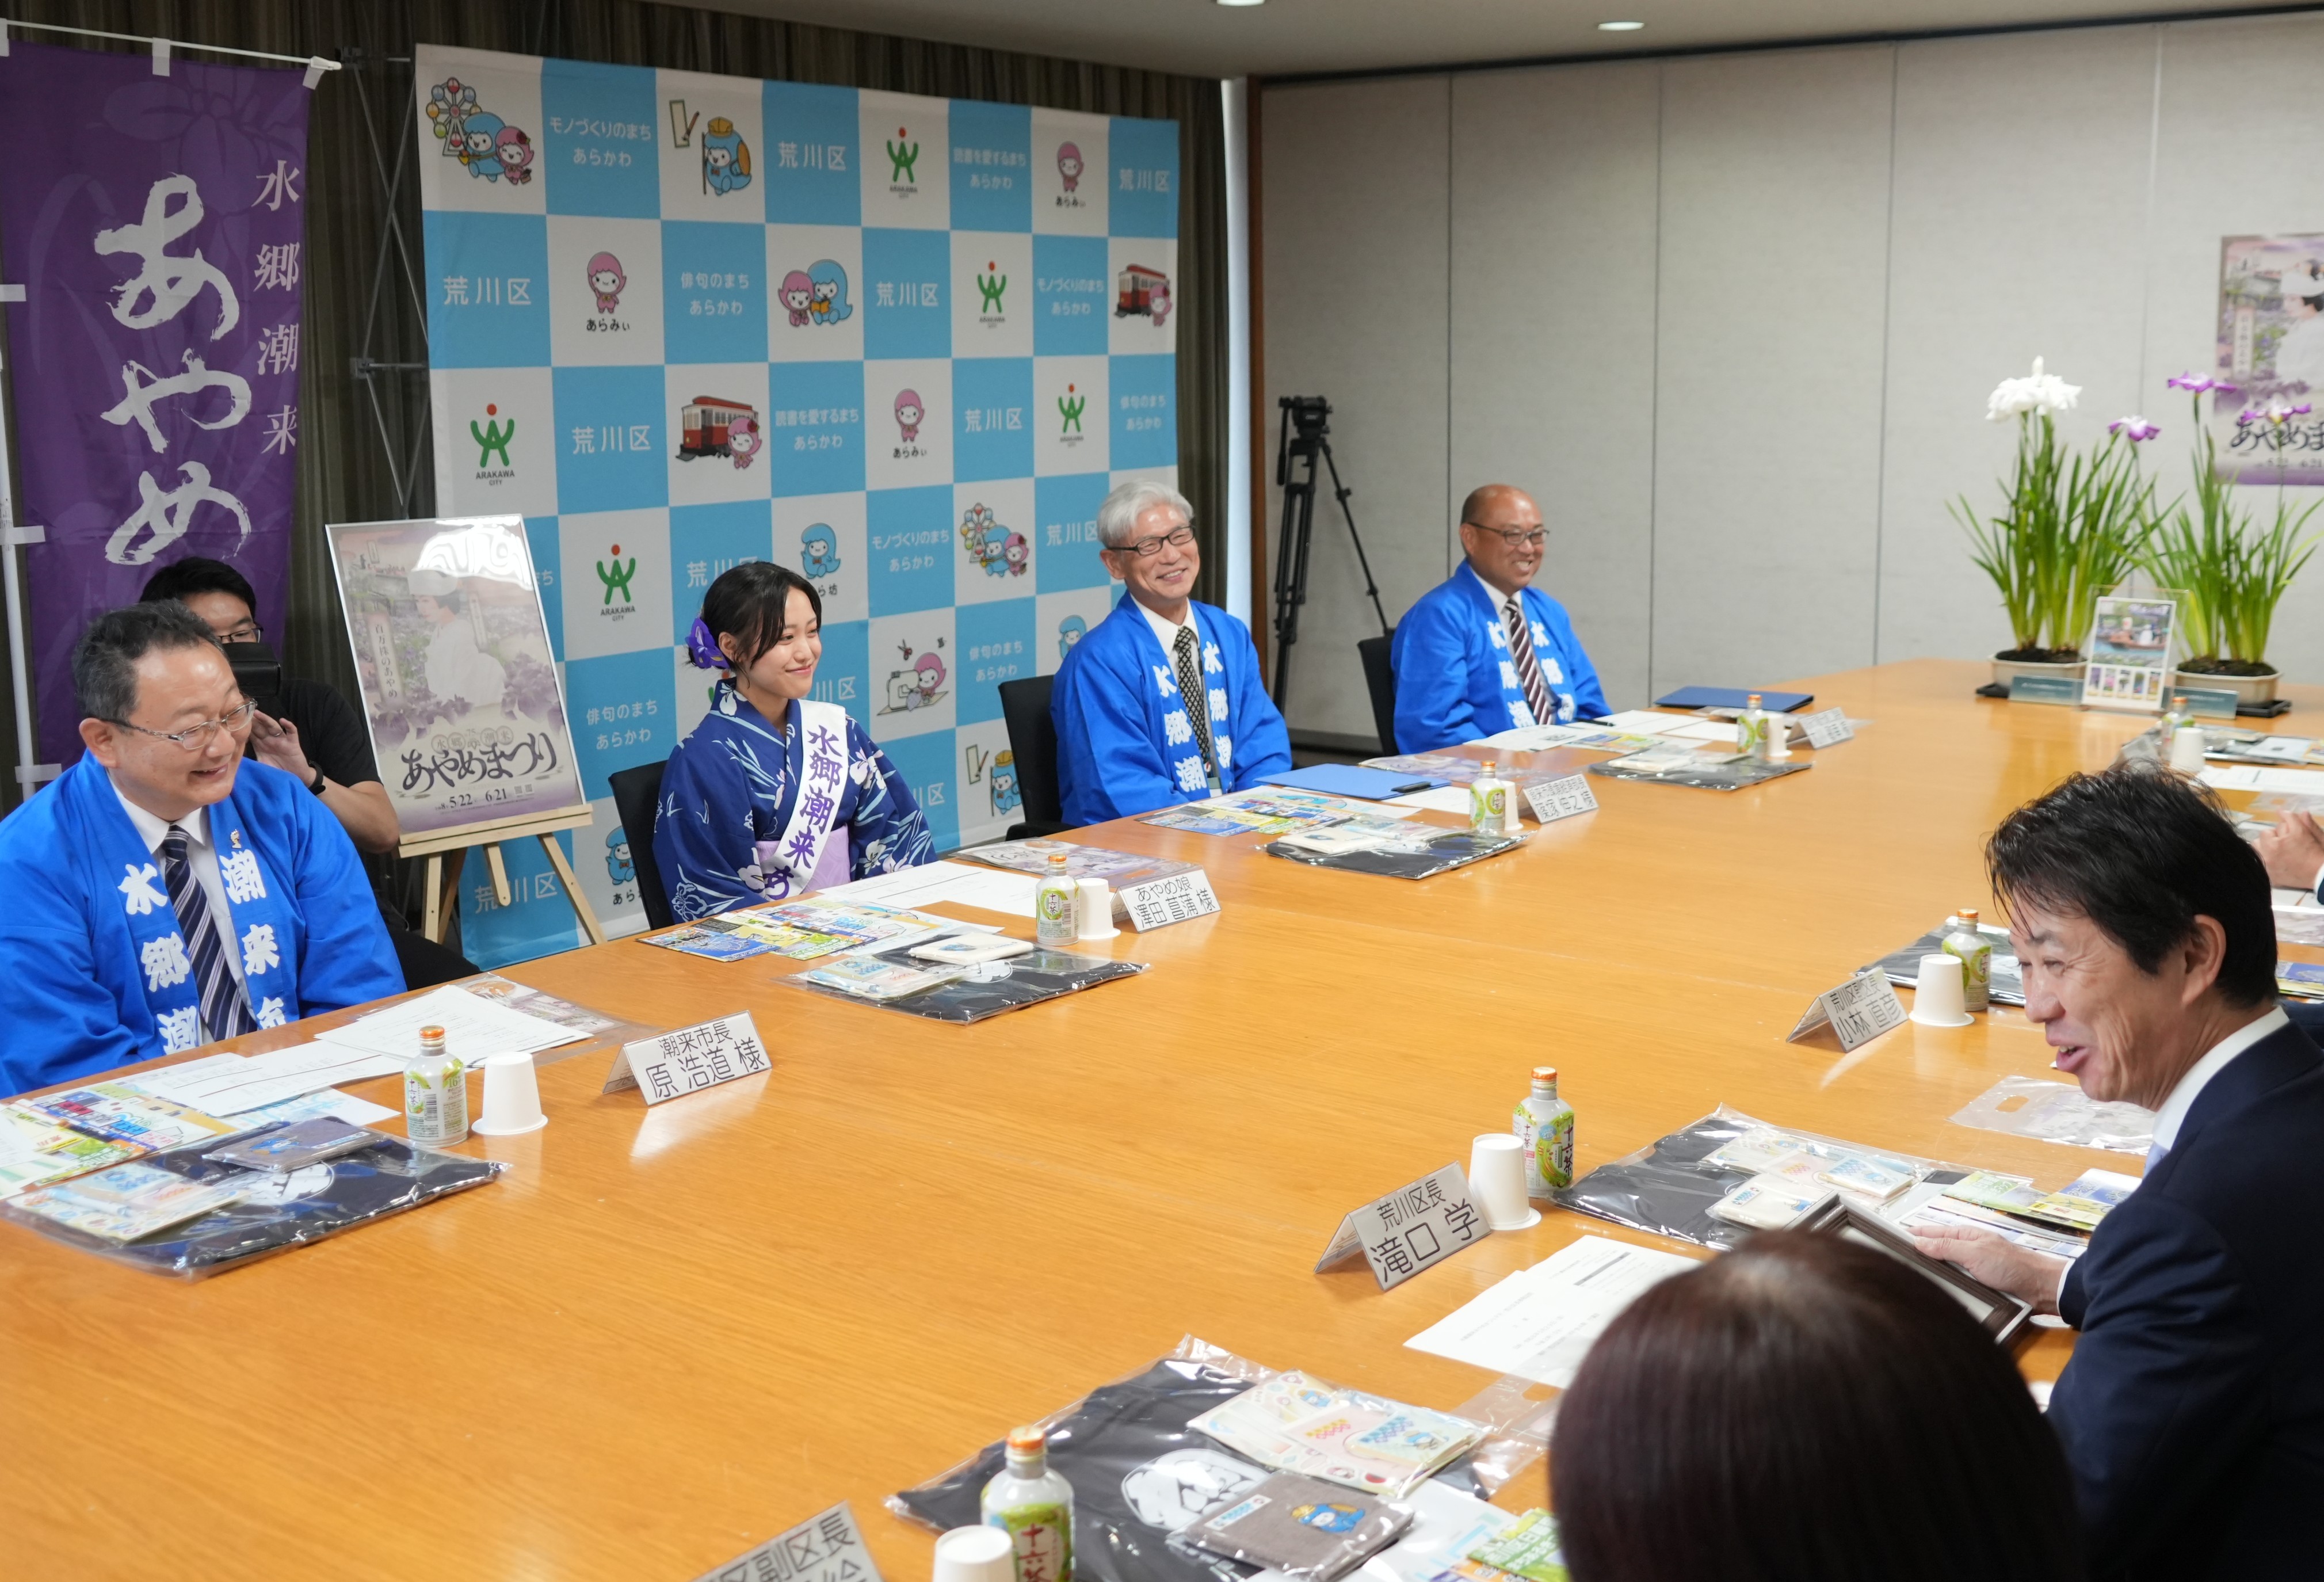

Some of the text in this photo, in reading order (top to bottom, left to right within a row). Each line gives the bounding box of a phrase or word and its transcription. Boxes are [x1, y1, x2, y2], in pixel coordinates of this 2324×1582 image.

[550, 117, 651, 140] モノづくりのまち
[573, 147, 631, 167] あらかわ
[778, 142, 846, 171] 荒川区
[1119, 169, 1170, 192] 荒川区
[444, 276, 532, 306] 荒川区
[681, 272, 749, 290] 俳句のまち
[876, 281, 938, 307] 荒川区
[251, 159, 300, 455] 水郷潮来
[690, 299, 743, 316] あらかわ
[94, 173, 251, 565] あやめ
[775, 407, 858, 426] 読書を愛するまち
[964, 408, 1022, 433] 荒川区
[572, 425, 651, 455] 荒川区
[794, 434, 842, 451] あらかわ
[476, 470, 515, 479] ARAKAWA
[872, 529, 949, 550] モノづくりのまち
[1046, 520, 1098, 546] 荒川区
[889, 555, 934, 572] あらかわ
[600, 605, 636, 616] ARAKAWA
[975, 664, 1017, 683] あらかわ
[816, 676, 856, 702] 川区
[586, 699, 657, 725] 俳句のまち
[596, 727, 651, 750] あらかわ
[401, 731, 557, 794] あやめまつり
[613, 889, 642, 905] あら
[1135, 875, 1192, 902] あやめ娘
[1048, 893, 1058, 916] 十六茶
[1134, 887, 1216, 928] 澤田 菖蒲 様
[1836, 1008, 1871, 1043] 小林
[658, 1020, 733, 1059] 潮来市長
[646, 1036, 765, 1099] 原 浩道 様
[409, 1078, 418, 1107] 十六茶
[1523, 1124, 1532, 1149] 十六茶
[1562, 1124, 1574, 1177] 十六茶
[1377, 1178, 1446, 1232] 荒川区長
[1369, 1198, 1479, 1283] 滝口 学
